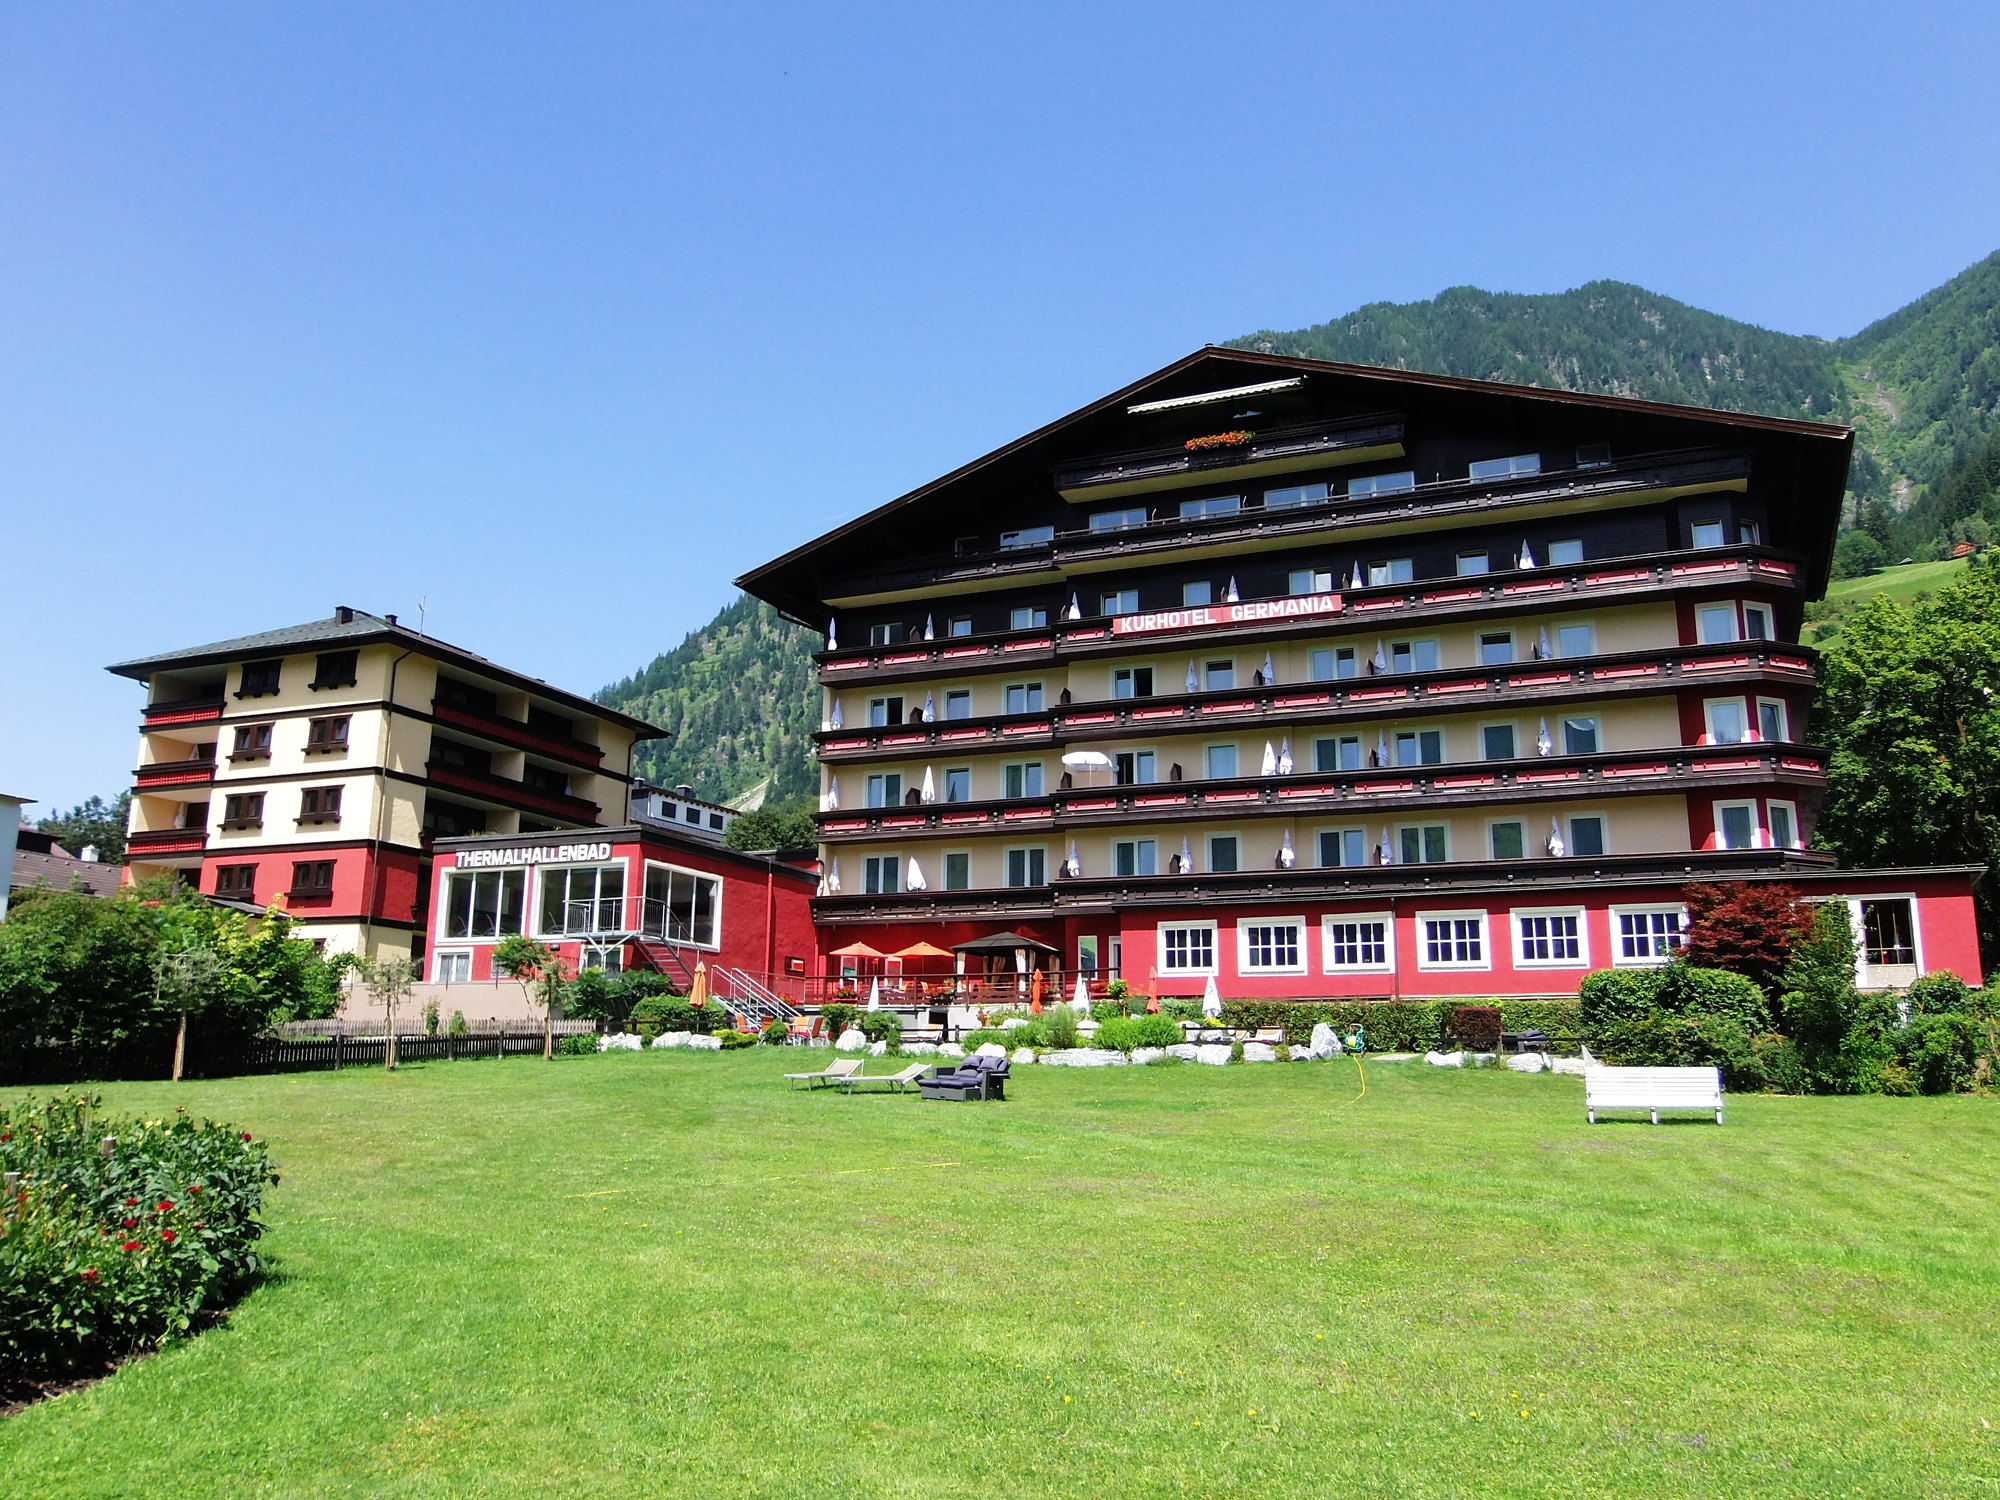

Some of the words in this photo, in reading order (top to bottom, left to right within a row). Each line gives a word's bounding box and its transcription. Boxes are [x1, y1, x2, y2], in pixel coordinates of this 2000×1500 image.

[1120, 608, 1216, 633] KURHOTEL
[1231, 595, 1334, 621] GERMANIA
[456, 843, 612, 867] THERMALHALLENBAD
